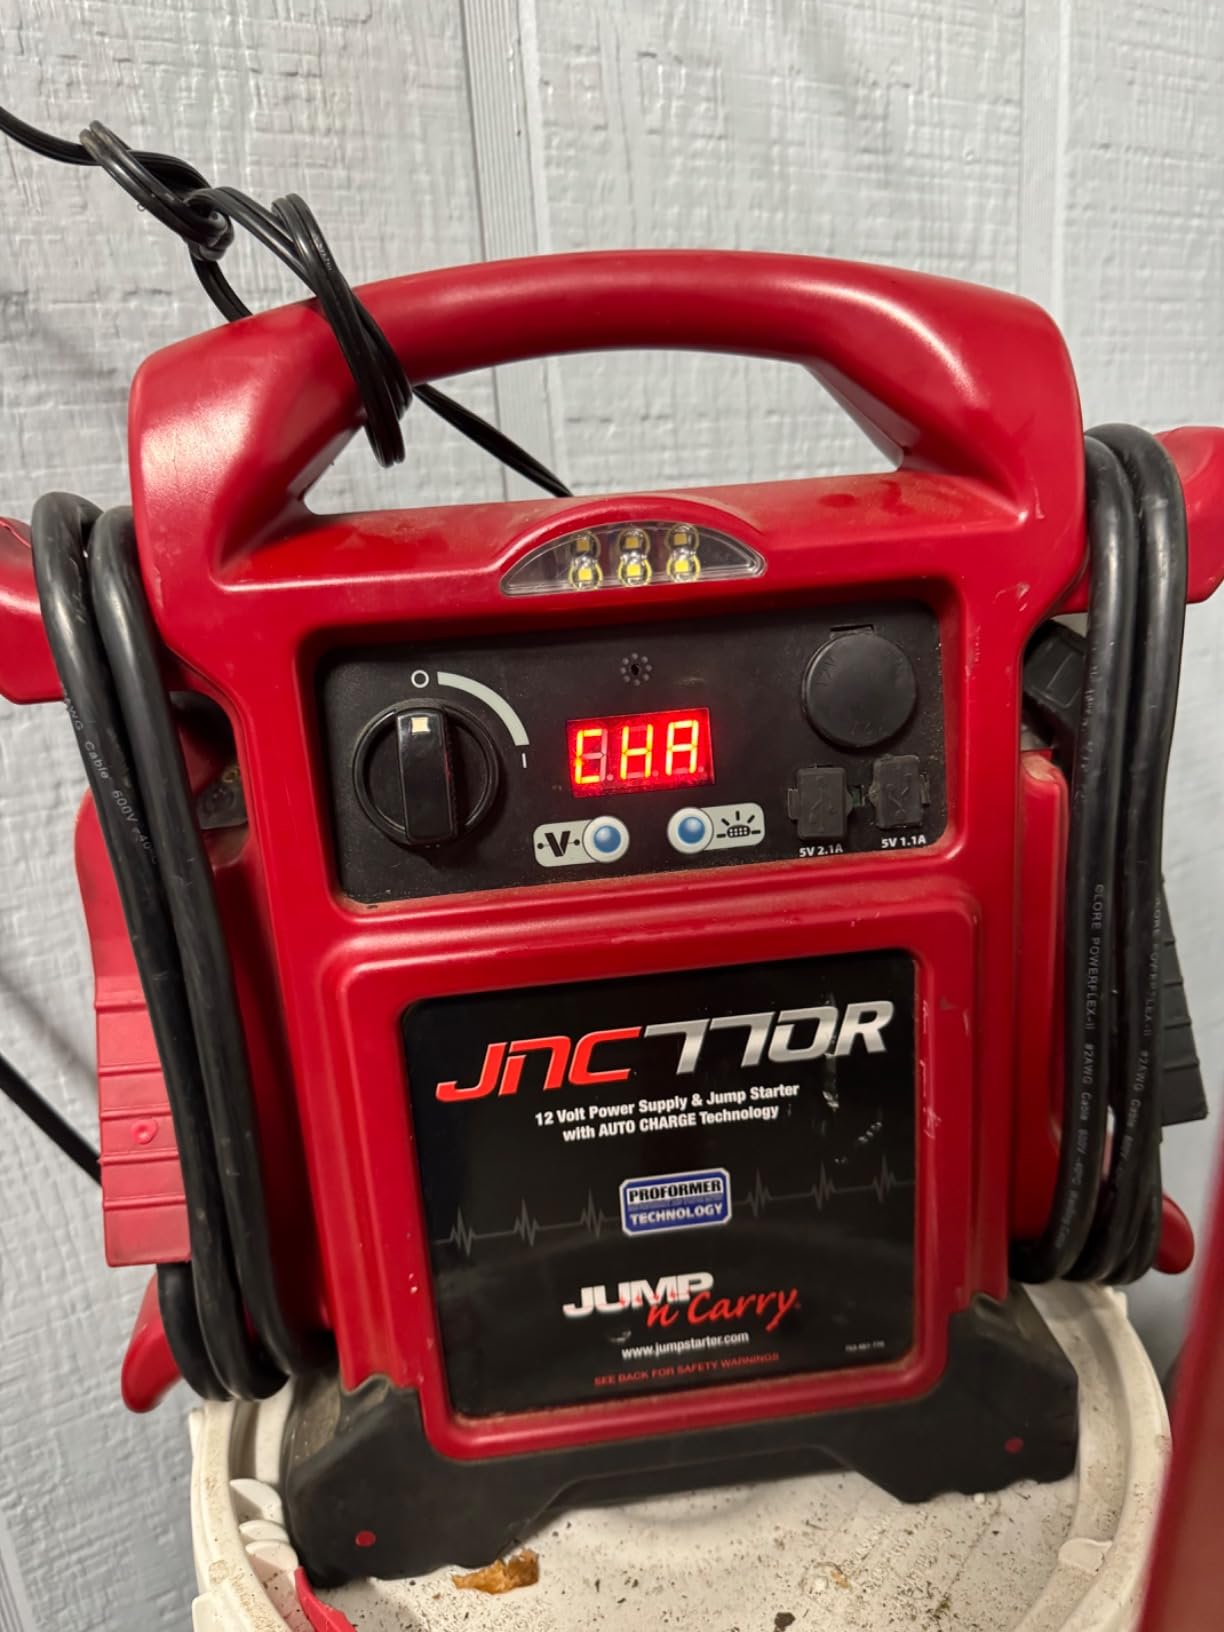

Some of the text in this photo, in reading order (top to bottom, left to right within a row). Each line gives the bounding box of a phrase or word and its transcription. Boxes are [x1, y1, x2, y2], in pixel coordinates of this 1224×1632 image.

[84, 740, 110, 780] Cable
[111, 789, 139, 823] 600V
[799, 842, 844, 858] 5V 2.1A
[881, 833, 927, 849] 5V 1.1A
[535, 1084, 800, 1126] 12 Volt Power Supply & Jump Starter
[563, 1105, 779, 1142] with AUTO CHARGE Technology
[629, 1179, 721, 1202] PROFORMER
[629, 1203, 723, 1226] TECHNOLOGY
[562, 1271, 714, 1319] JUMP
[687, 1287, 798, 1333] Carry
[621, 1331, 750, 1361] www.jumpstarter.com
[594, 1352, 780, 1387] SEE BACK FOR SAFETY WARNINGS
